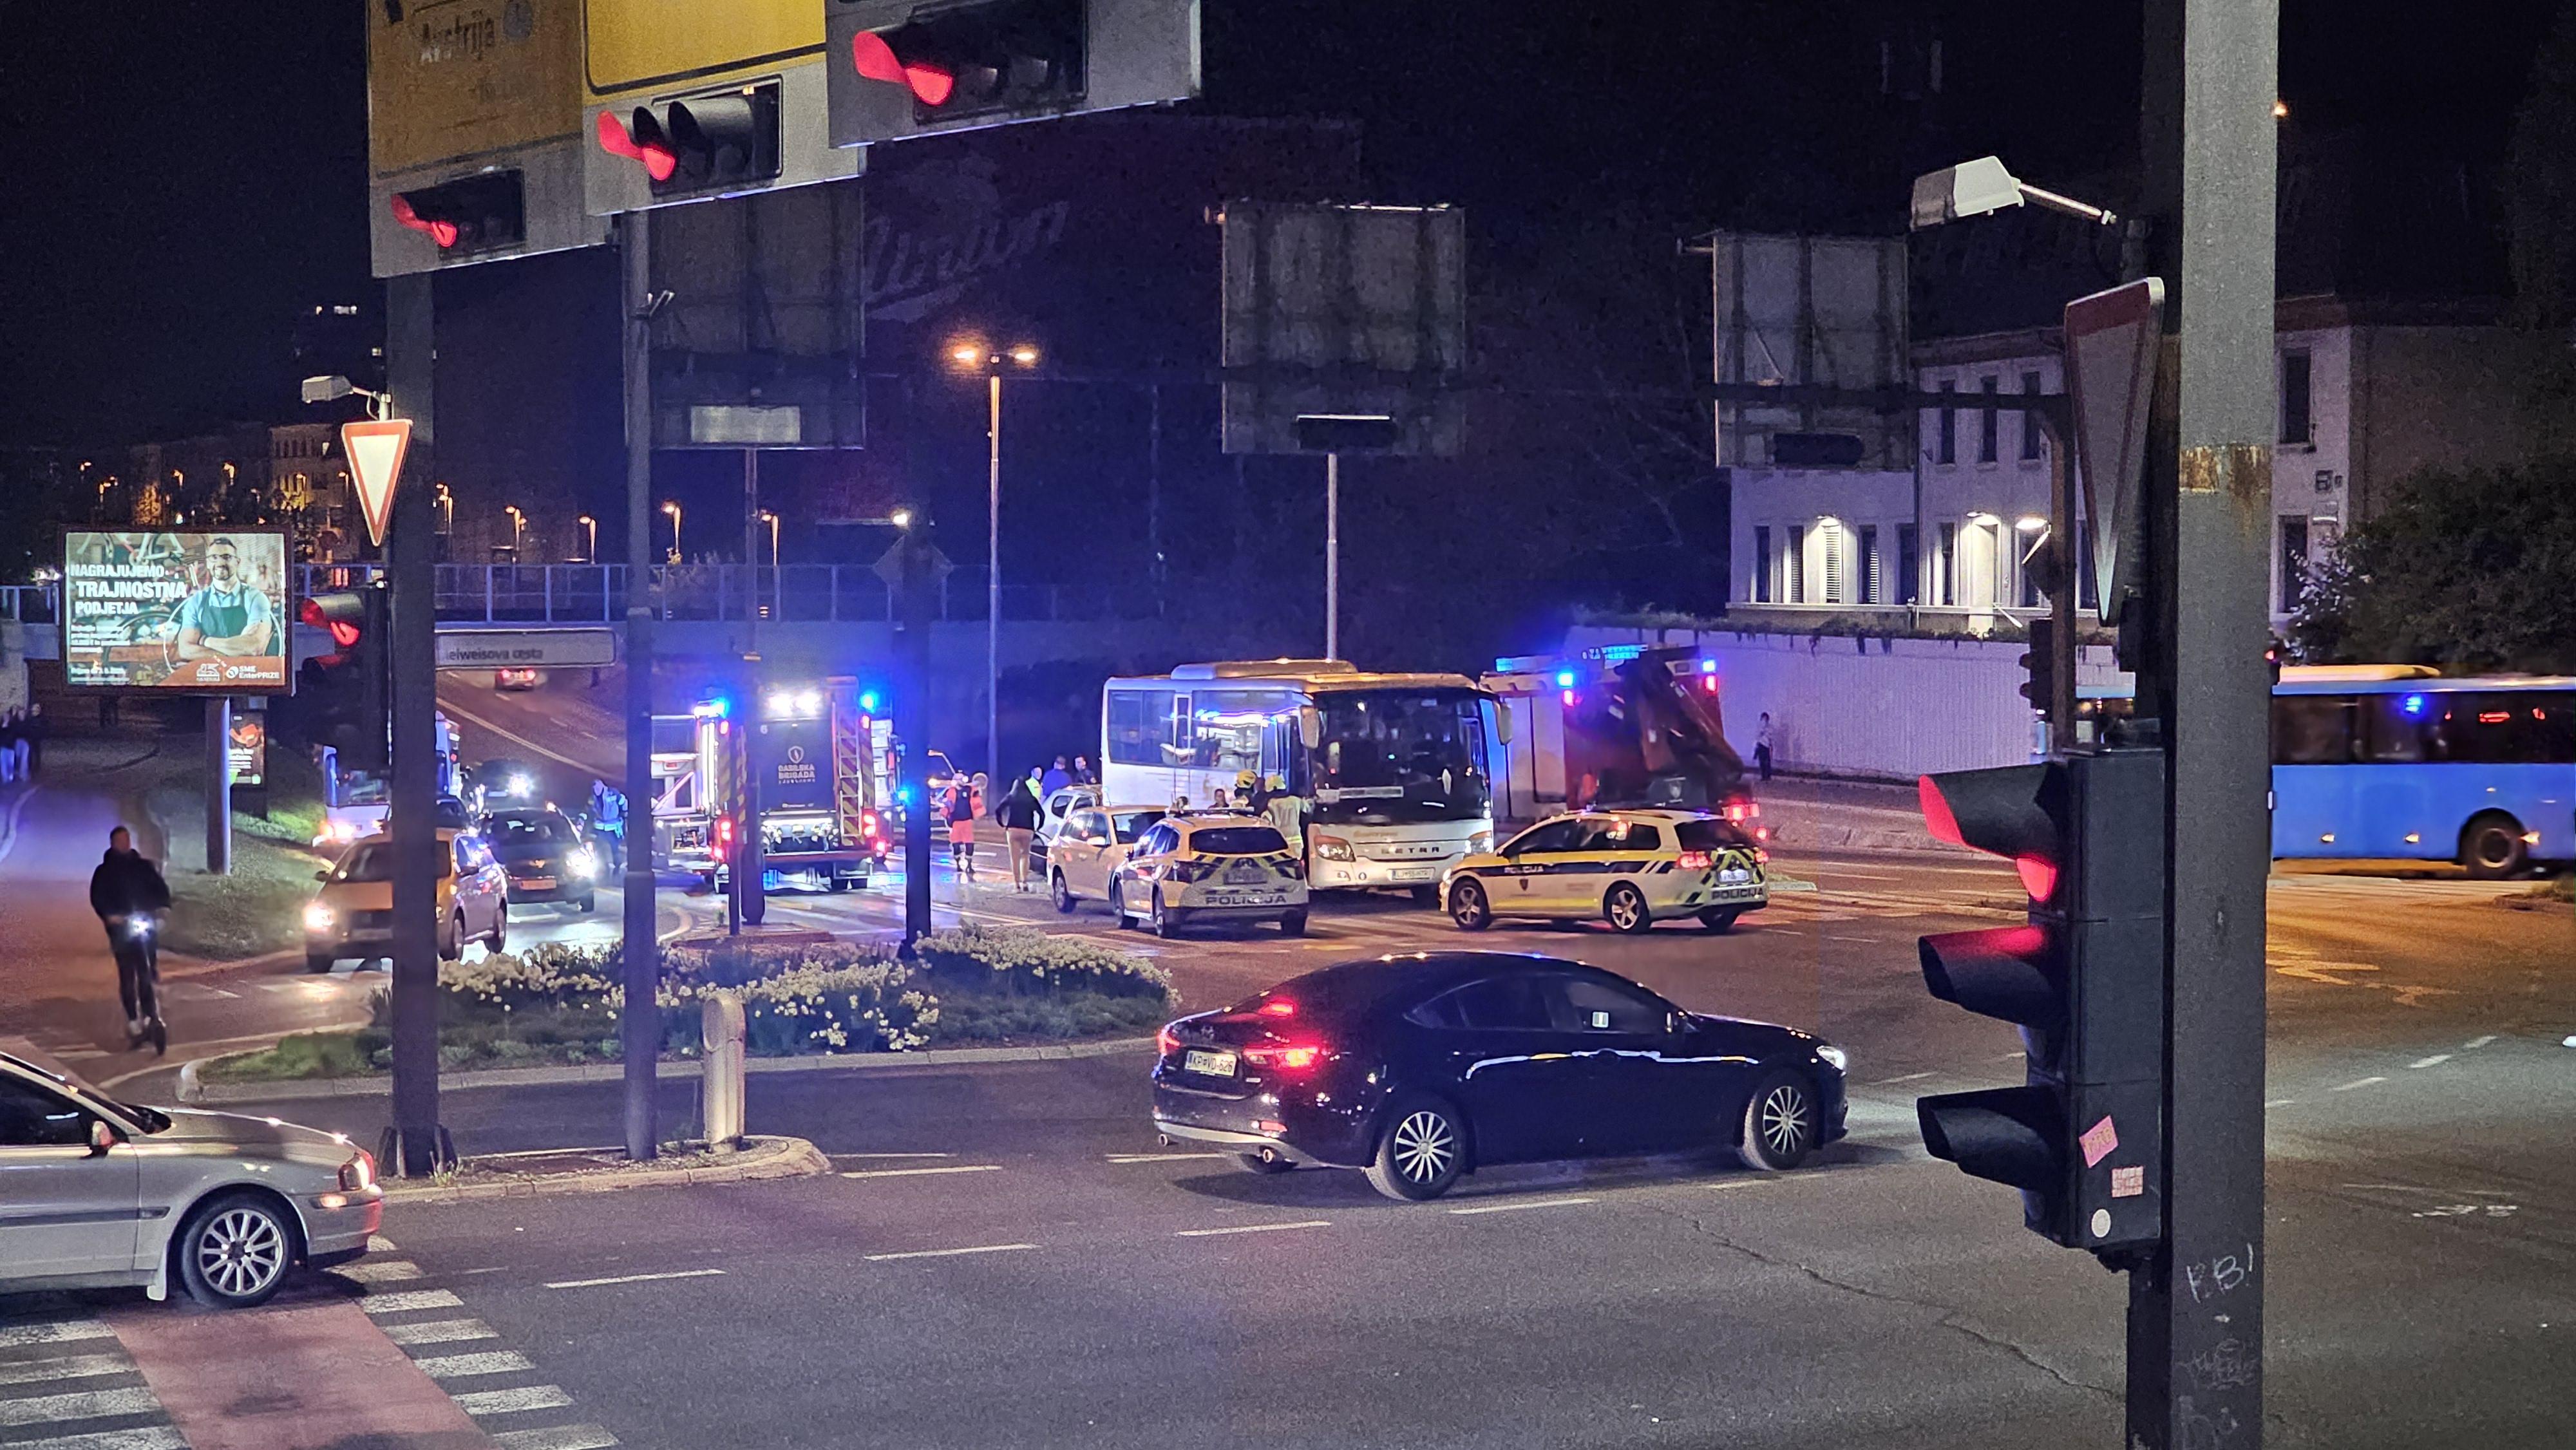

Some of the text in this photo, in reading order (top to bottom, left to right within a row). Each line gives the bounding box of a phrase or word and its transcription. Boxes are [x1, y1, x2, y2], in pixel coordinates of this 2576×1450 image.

[70, 563, 165, 578] NAGRAJUJEMO
[75, 580, 187, 599] TRAJNOSTNA
[75, 601, 139, 615] PODJETJA
[1204, 892, 1287, 906] POLICIJA
[1710, 887, 1765, 900] POLICIJA
